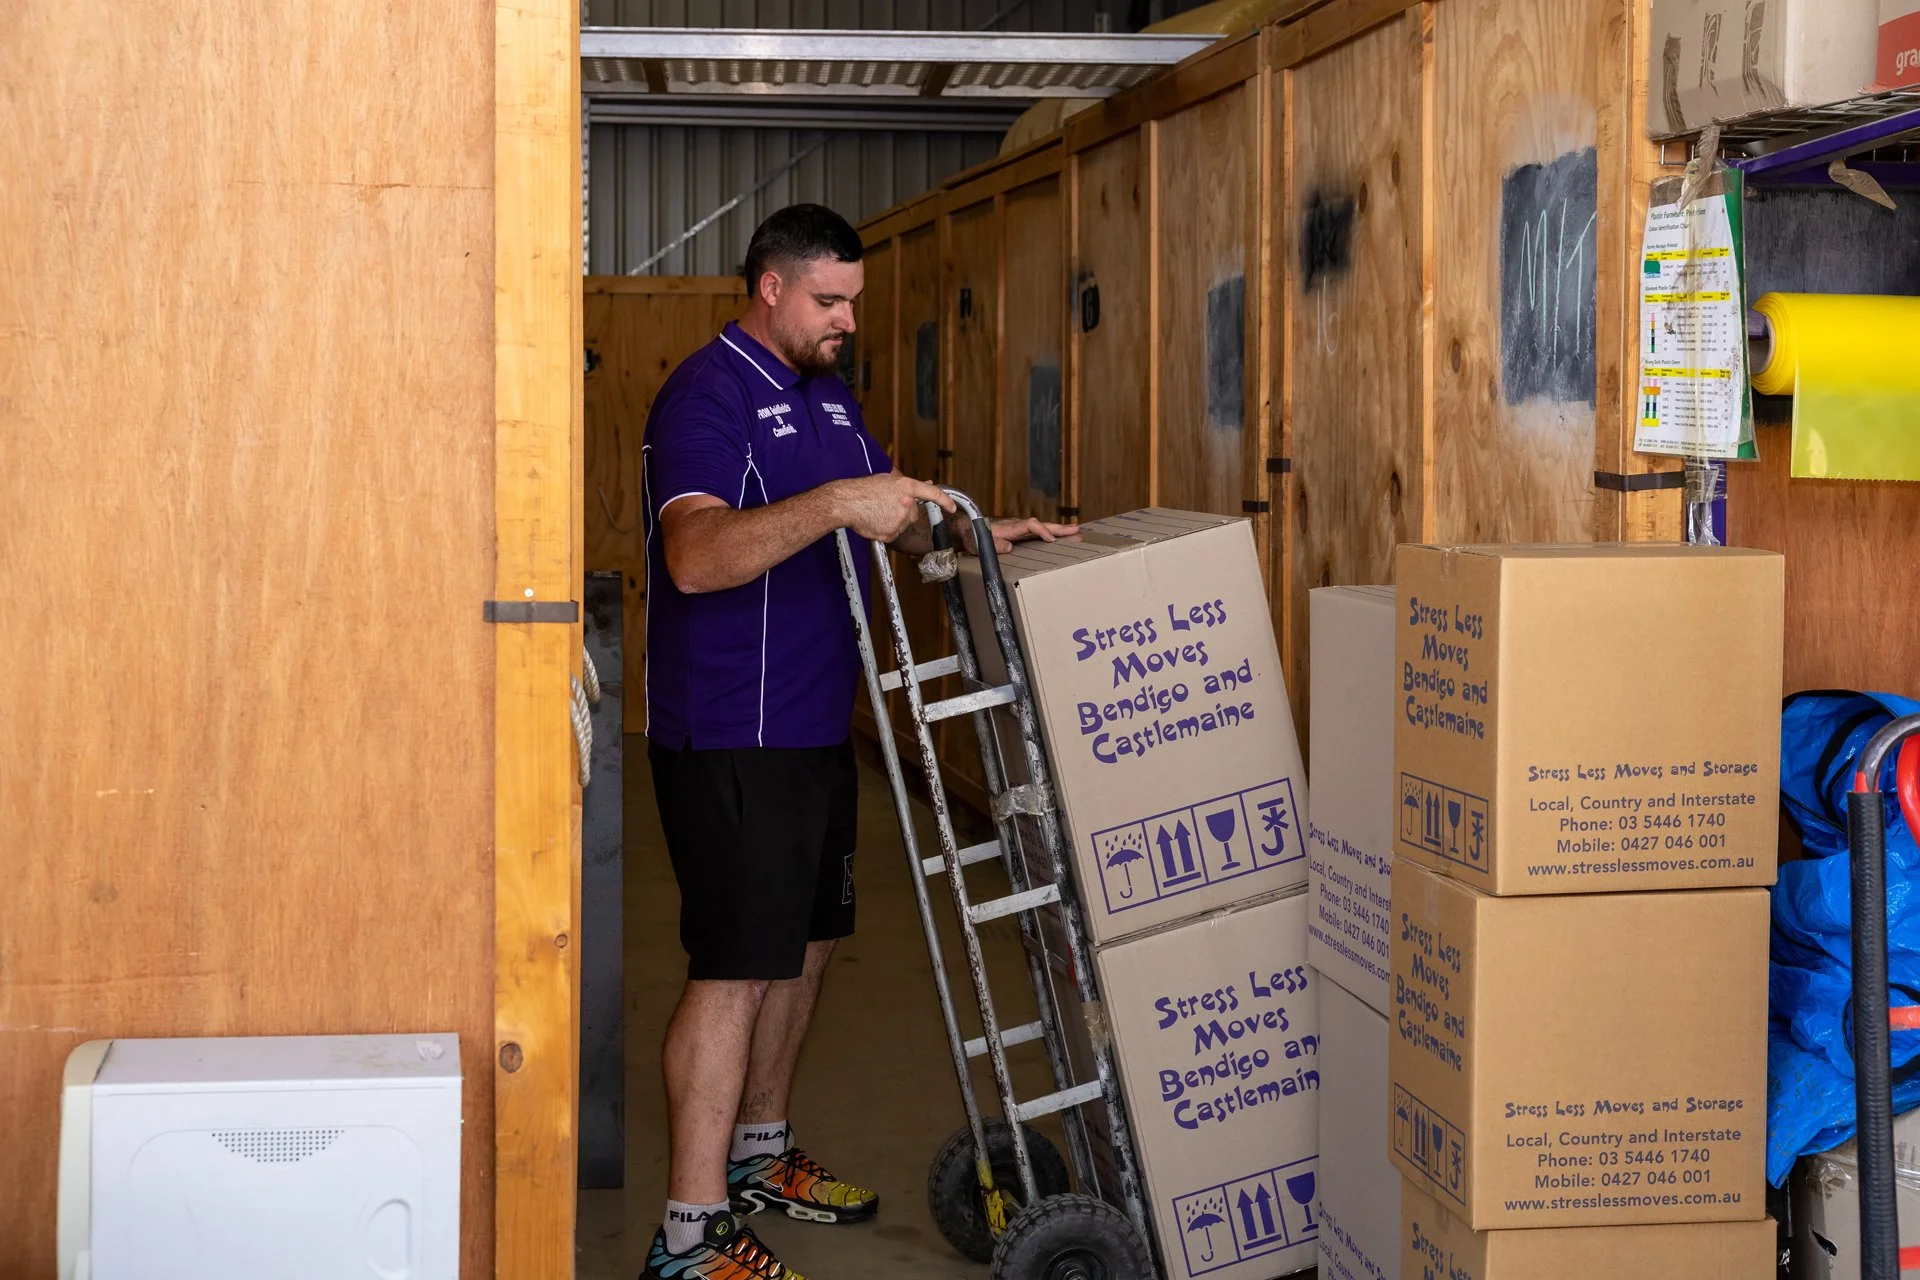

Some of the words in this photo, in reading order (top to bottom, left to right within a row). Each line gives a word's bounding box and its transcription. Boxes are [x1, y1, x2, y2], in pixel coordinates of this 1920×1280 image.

[1072, 617, 1157, 662] Stress
[1167, 599, 1227, 632] Less
[1409, 596, 1448, 633] Stress
[1455, 604, 1483, 640] Less
[1111, 640, 1209, 689] Moves
[1421, 633, 1469, 672] Moves
[1076, 683, 1189, 736] Bendigo
[1203, 657, 1253, 695] and
[1403, 660, 1456, 701] Bendigo
[1462, 680, 1488, 706] and
[1092, 702, 1255, 764] Castlemaine
[1406, 695, 1485, 741] Castlemaine
[1528, 765, 1570, 782] Stress
[1577, 764, 1606, 781] Less
[1614, 763, 1663, 779] Moves
[1670, 762, 1696, 777] and
[1703, 760, 1758, 778] Storage
[1529, 796, 1575, 812] Local,
[1580, 795, 1643, 812] Country
[1647, 793, 1676, 808] and
[1681, 792, 1756, 807] Interstate
[1560, 817, 1613, 832] Phone:
[1618, 816, 1638, 830] 03
[1643, 814, 1682, 829] 5446
[1688, 812, 1726, 827] 1740
[1309, 822, 1325, 846] Stress
[1327, 830, 1339, 853] Less
[1341, 838, 1362, 865] Moves
[1364, 852, 1377, 869] and
[1378, 856, 1392, 877] Sto
[1527, 856, 1755, 876] www.stresslessmoves.com.au
[1557, 838, 1616, 854] Mobile:
[1621, 836, 1659, 851] 0427
[1665, 835, 1693, 849] 046
[1699, 834, 1726, 848] 001
[1309, 855, 1327, 879] Local,
[1328, 865, 1353, 896] Country
[1354, 883, 1368, 900] and
[1319, 904, 1343, 931] Mobile:
[1344, 919, 1361, 941] 0427
[1362, 932, 1375, 951] 046
[1377, 939, 1389, 960] 001
[1320, 883, 1342, 908] Phone:
[1342, 896, 1351, 913] 03
[1353, 904, 1370, 924] 5446
[1372, 912, 1389, 935] 1740
[1401, 912, 1433, 957] Stress
[1438, 932, 1461, 973] Less
[1154, 985, 1239, 1030] Stress
[1248, 965, 1308, 998] Less
[1411, 953, 1449, 1001] Moves
[1396, 974, 1439, 1022] Bendigo
[1444, 1009, 1465, 1039] and
[1193, 1007, 1289, 1056] Moves
[1398, 1008, 1462, 1072] Castlemaine
[1159, 1049, 1270, 1102] Bendigo
[1284, 1034, 1321, 1059] an
[1504, 1102, 1548, 1119] Stress
[1555, 1100, 1585, 1117] Less
[1593, 1099, 1645, 1116] Moves
[1652, 1098, 1679, 1113] and
[1686, 1096, 1744, 1113] Storage
[743, 1130, 785, 1141] FILA
[1506, 1132, 1553, 1149] Local,
[1558, 1131, 1624, 1149] Country
[1628, 1129, 1658, 1144] and
[1664, 1128, 1742, 1143] Interstate
[1538, 1152, 1593, 1168] Phone:
[1599, 1151, 1619, 1166] 03
[1624, 1150, 1665, 1165] 5446
[1671, 1148, 1710, 1163] 1740
[1504, 1192, 1742, 1211] www.stresslessmoves.com.au
[1535, 1173, 1596, 1189] Mobile:
[1601, 1172, 1641, 1187] 0427
[1647, 1170, 1677, 1185] 046
[1683, 1169, 1711, 1184] 001
[670, 1210, 712, 1223] FILA
[1412, 1222, 1444, 1274] Stress
